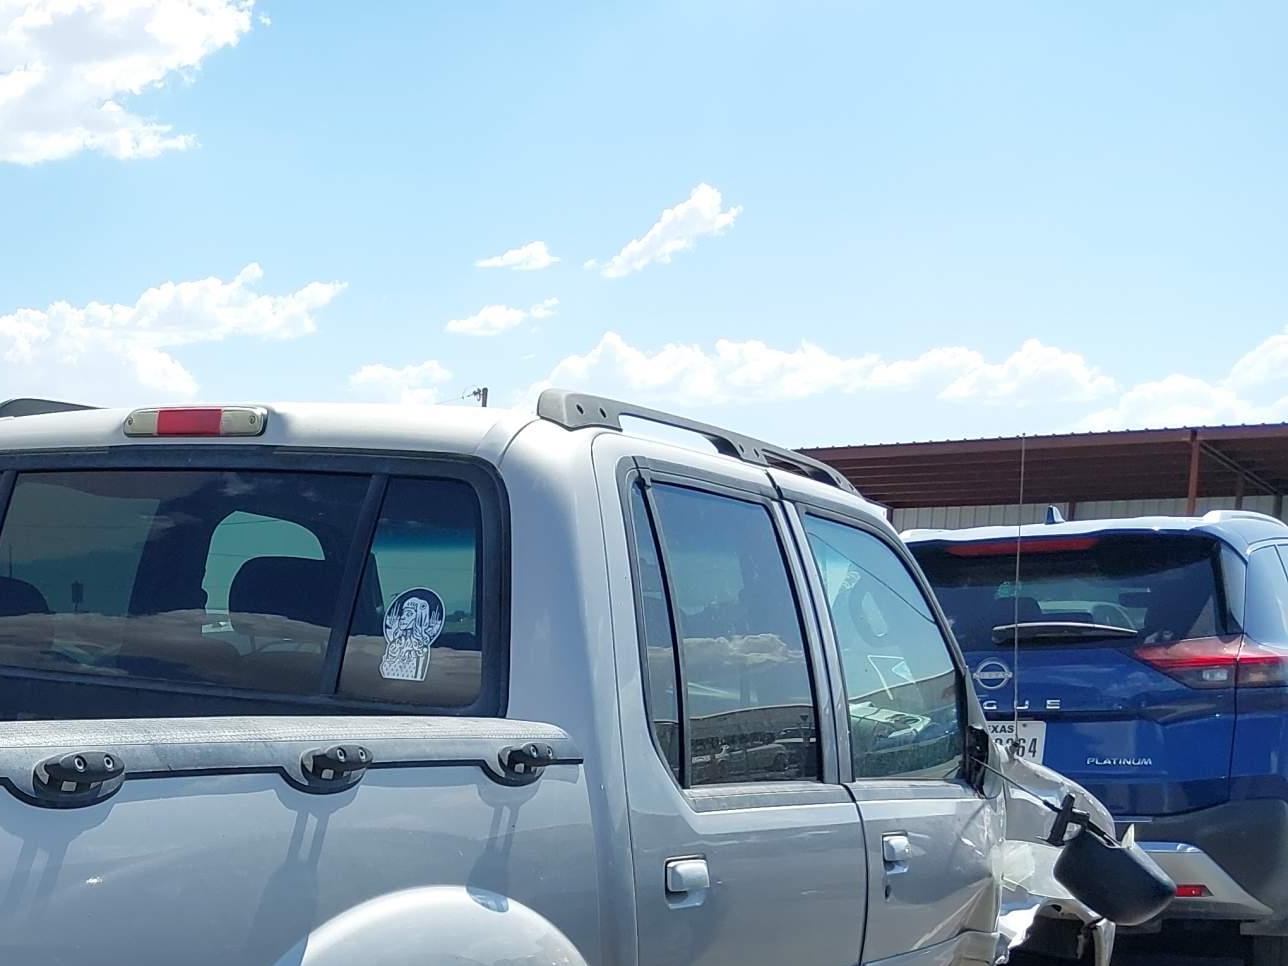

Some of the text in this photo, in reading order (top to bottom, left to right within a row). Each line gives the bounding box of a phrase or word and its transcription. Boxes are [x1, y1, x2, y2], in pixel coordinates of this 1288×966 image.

[982, 699, 1061, 710] GUE
[987, 724, 1015, 734] XAS
[1086, 757, 1152, 766] PLATINUM
